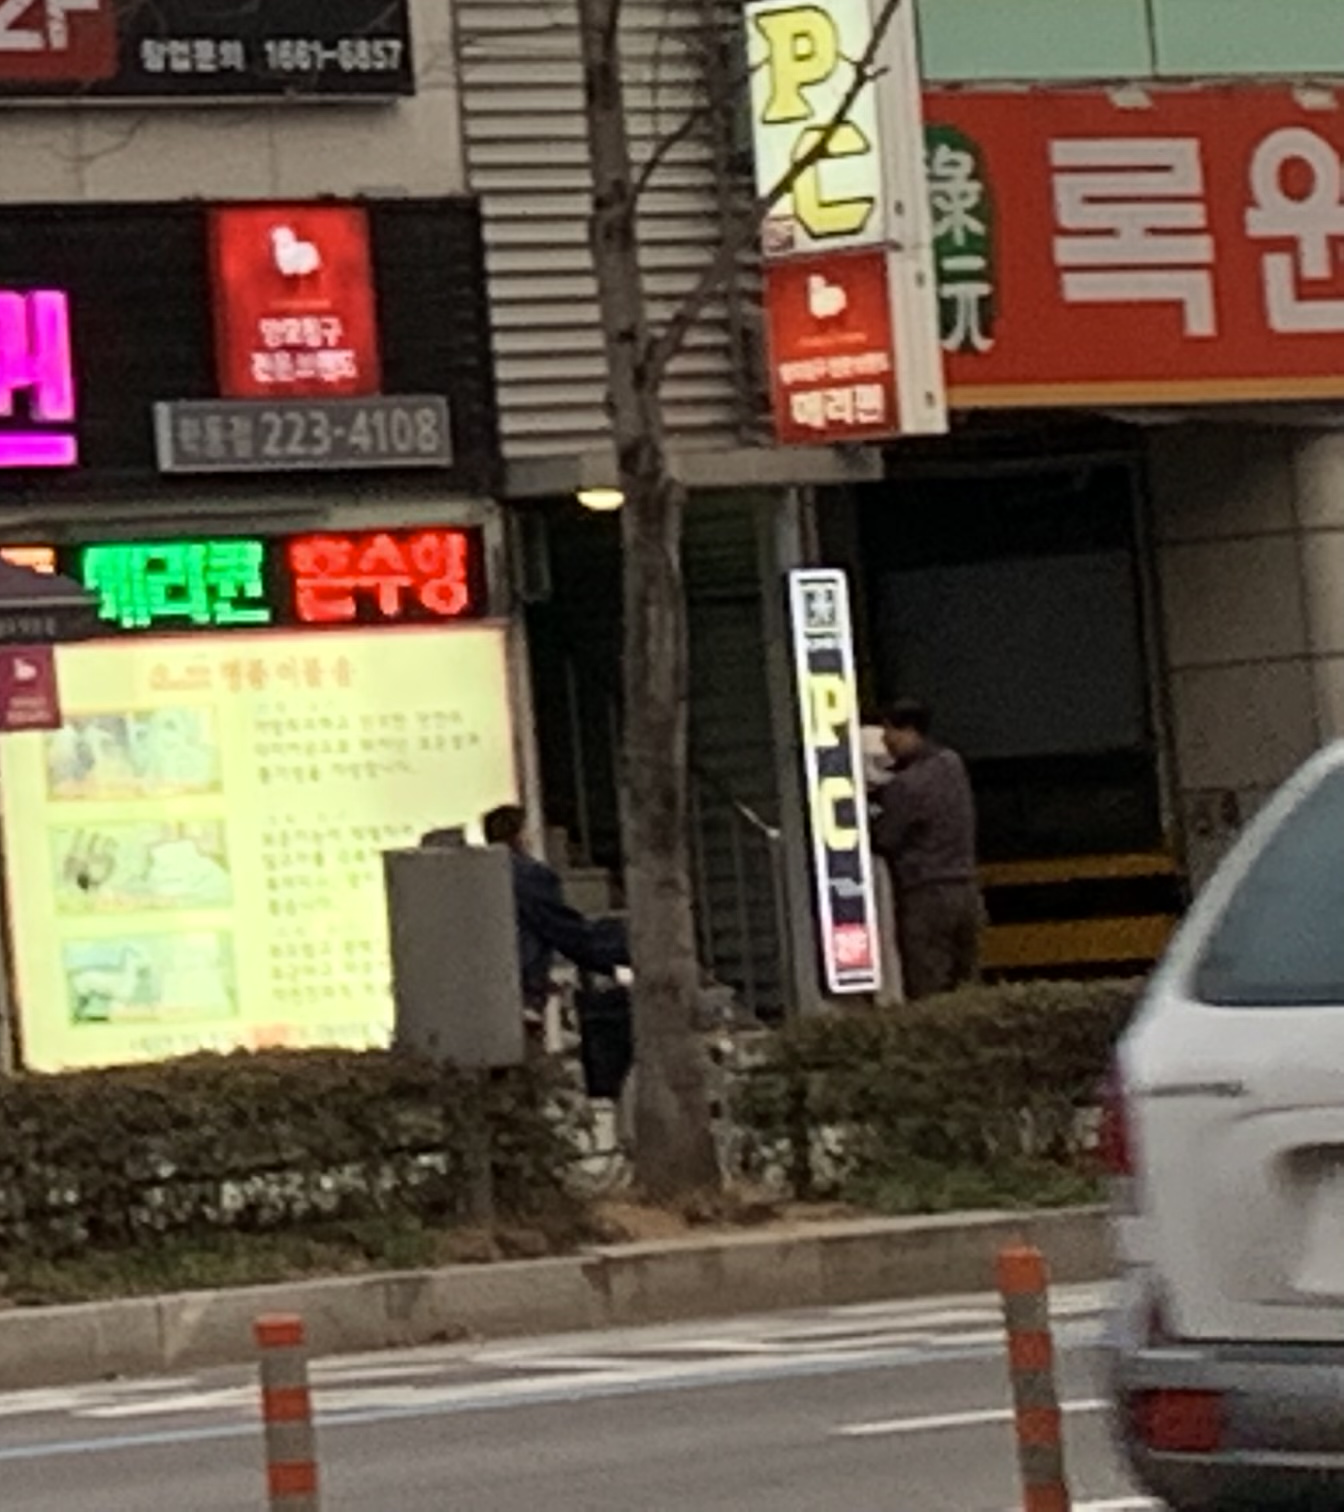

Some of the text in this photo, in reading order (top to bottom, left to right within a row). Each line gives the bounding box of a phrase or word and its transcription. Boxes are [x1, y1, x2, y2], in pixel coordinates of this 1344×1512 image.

[754, 4, 877, 240] PC
[261, 406, 441, 458] 223-4108
[808, 671, 860, 851] PC
